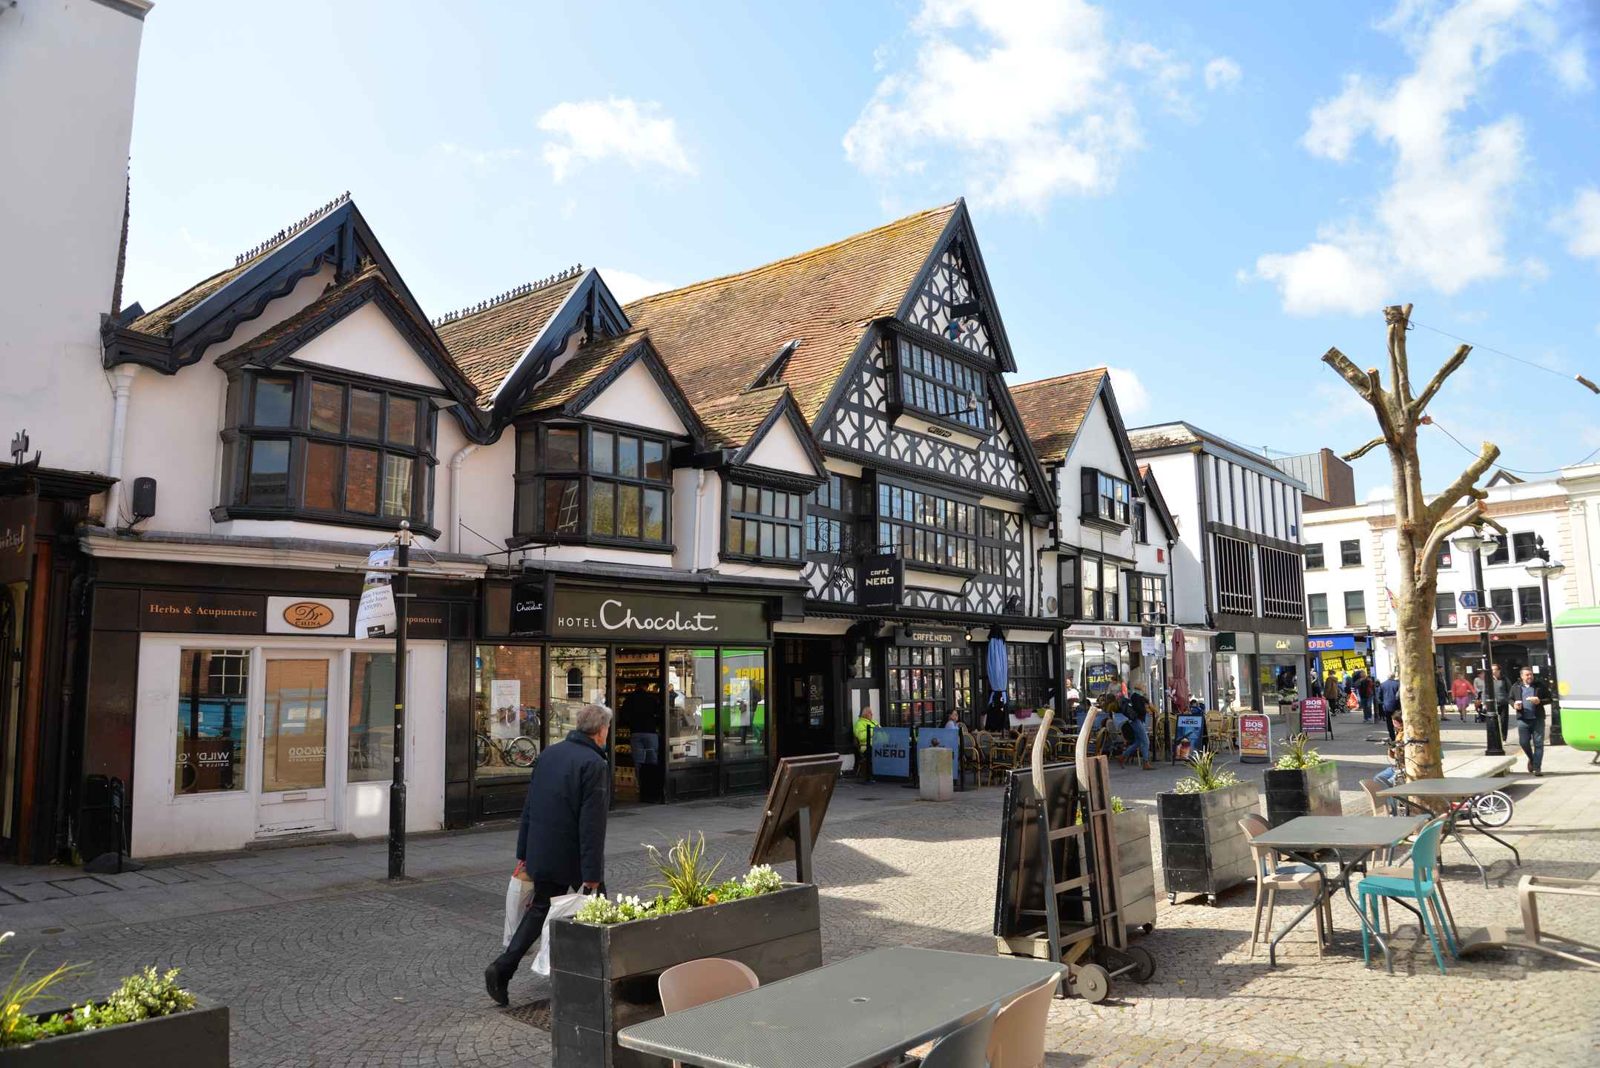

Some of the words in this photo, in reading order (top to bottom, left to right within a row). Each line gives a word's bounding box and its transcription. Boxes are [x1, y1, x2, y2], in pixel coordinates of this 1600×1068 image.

[865, 576, 894, 586] NERO
[150, 604, 180, 614] Herbs
[183, 605, 192, 614] &
[196, 607, 258, 618] Acupuncture
[294, 605, 323, 621] Dr
[406, 617, 442, 625] puncture
[558, 616, 597, 628] HOTEL
[934, 634, 952, 642] NERO
[874, 750, 905, 758] NERO
